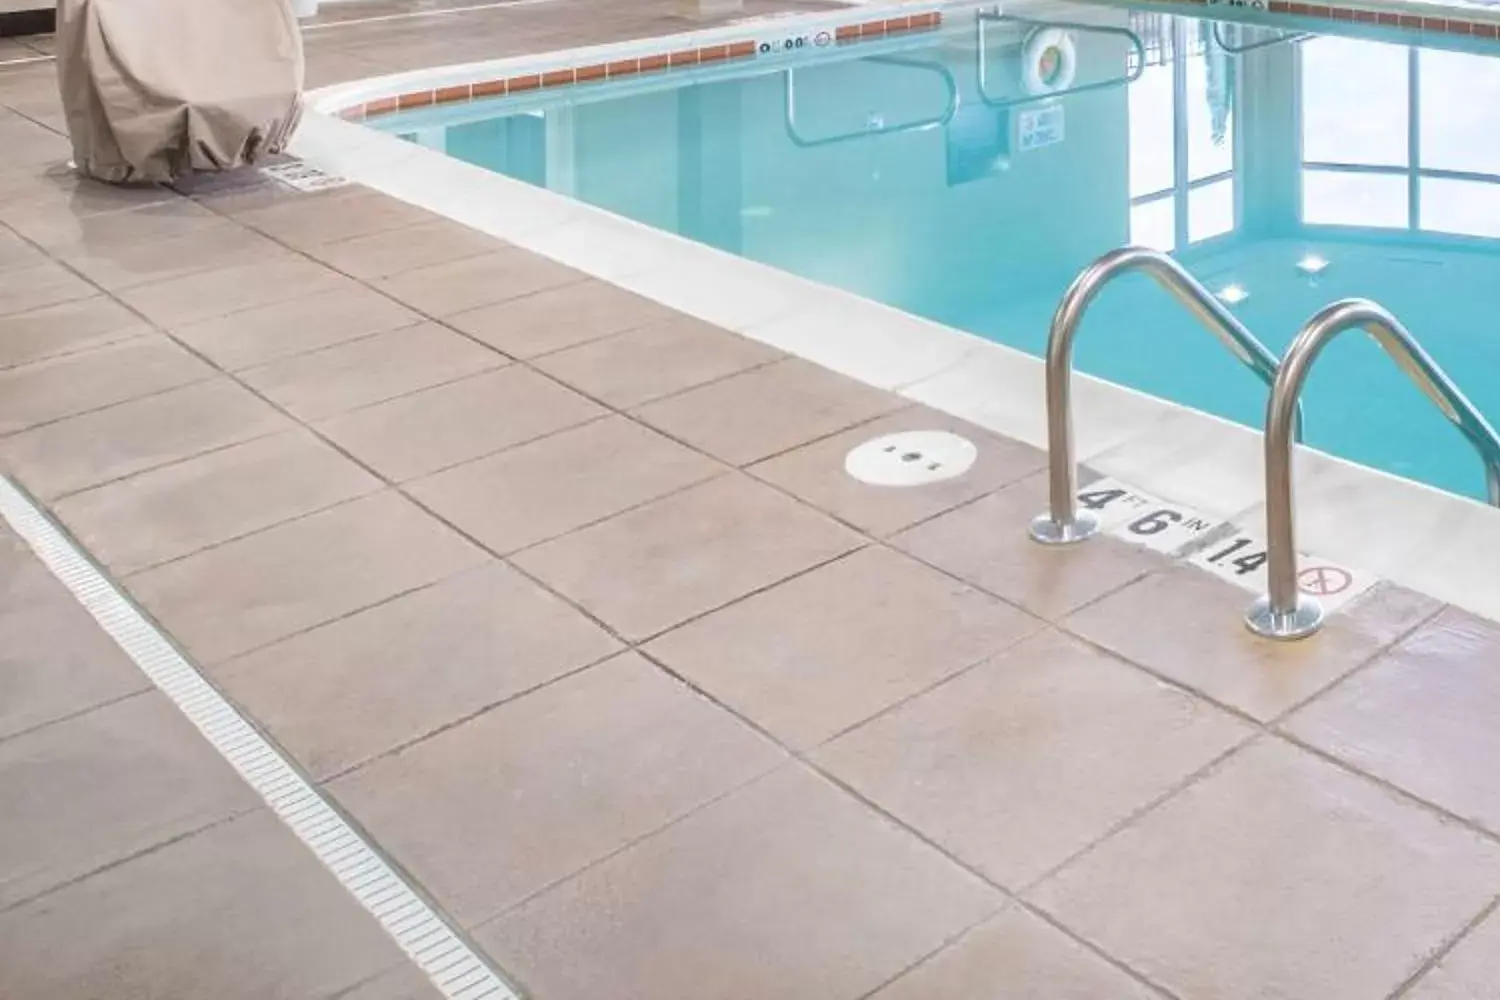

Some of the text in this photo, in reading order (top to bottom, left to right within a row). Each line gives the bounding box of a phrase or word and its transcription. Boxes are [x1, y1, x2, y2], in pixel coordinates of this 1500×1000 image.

[1077, 489, 1127, 509] 4
[1123, 493, 1149, 508] FT
[1128, 509, 1182, 536] 6
[1181, 516, 1210, 532] IN
